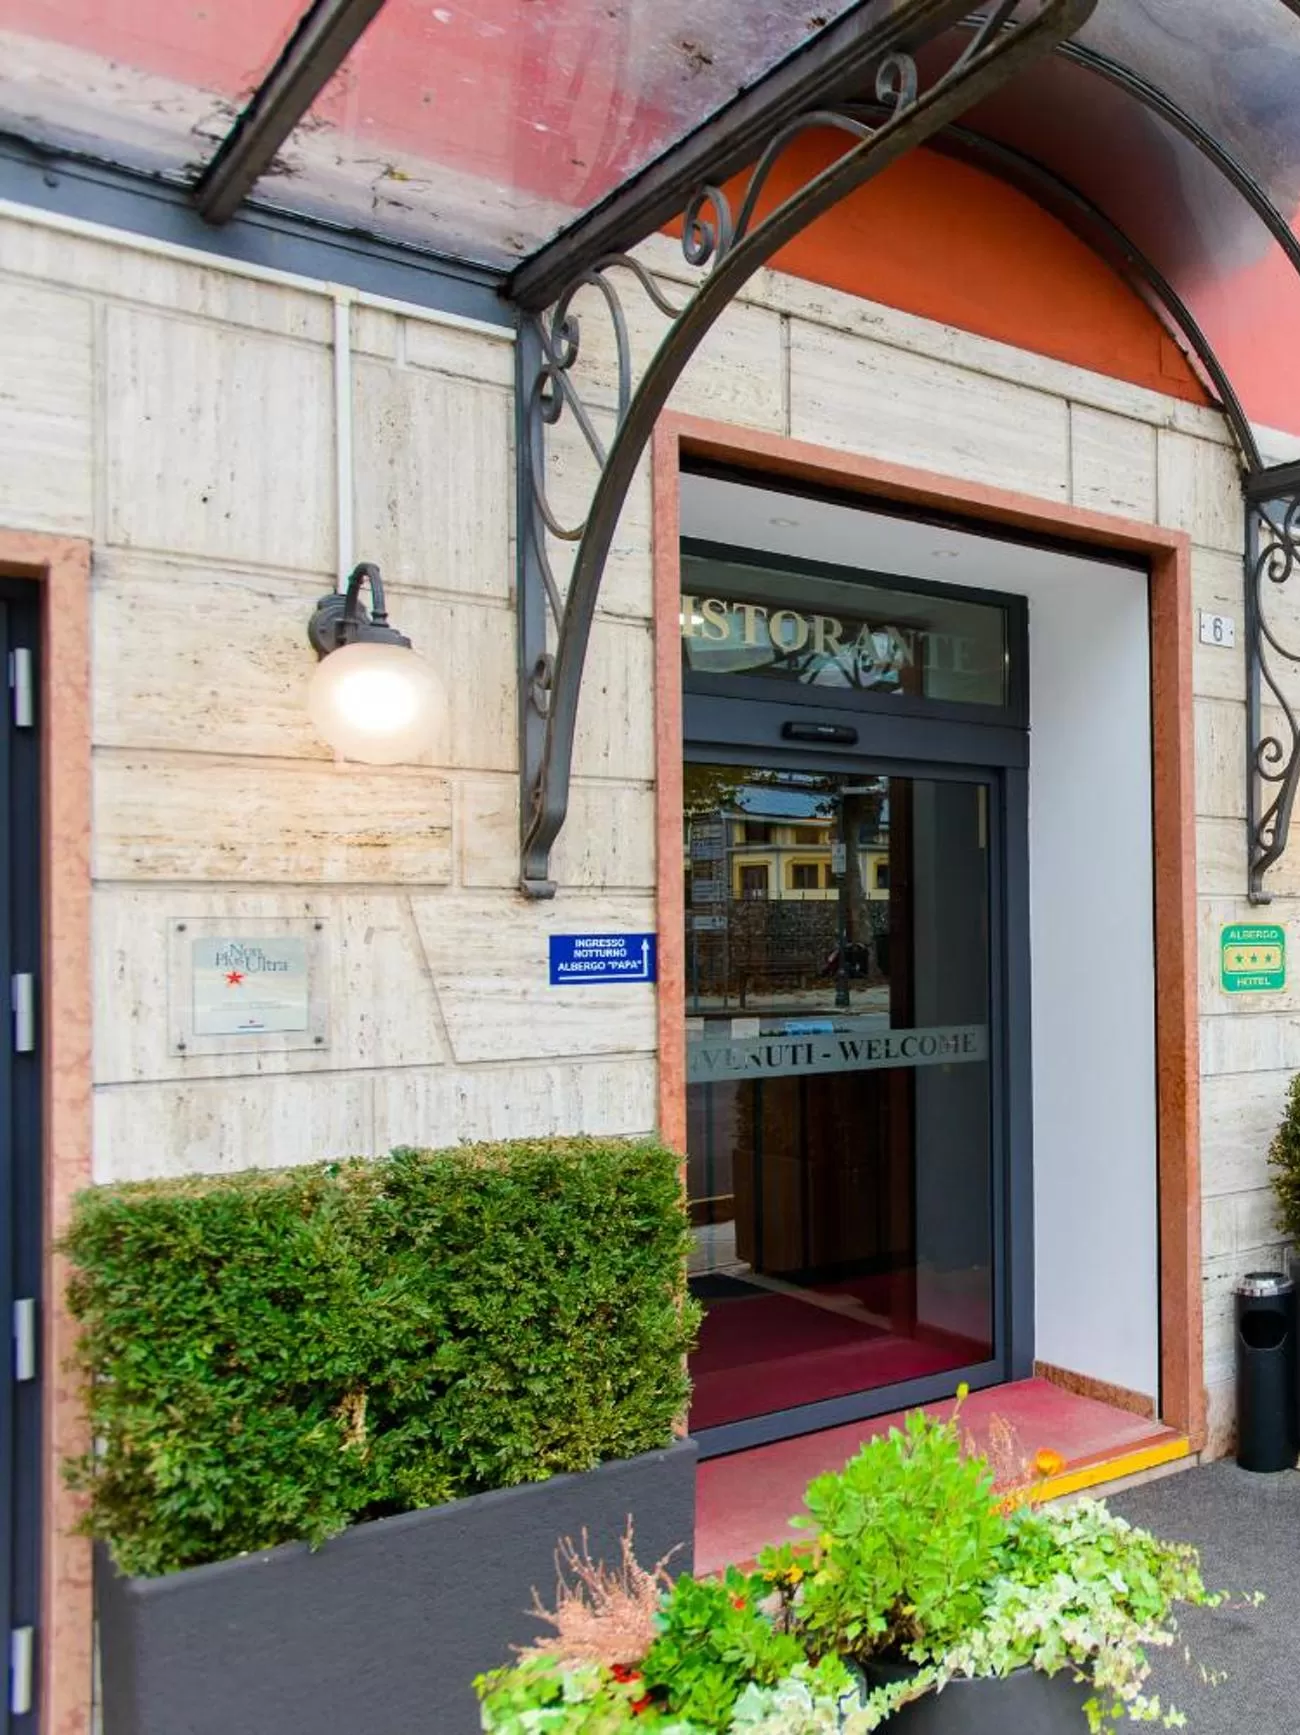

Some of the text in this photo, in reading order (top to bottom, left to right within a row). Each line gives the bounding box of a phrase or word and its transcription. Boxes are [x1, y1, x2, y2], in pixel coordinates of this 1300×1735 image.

[1212, 617, 1223, 642] 6
[230, 943, 263, 958] Non
[575, 938, 625, 948] INGRESSO
[573, 948, 627, 958] NOTTURNO
[245, 956, 290, 973] Ultra
[557, 961, 606, 972] ALBERGO
[838, 1033, 977, 1062] WELCOME
